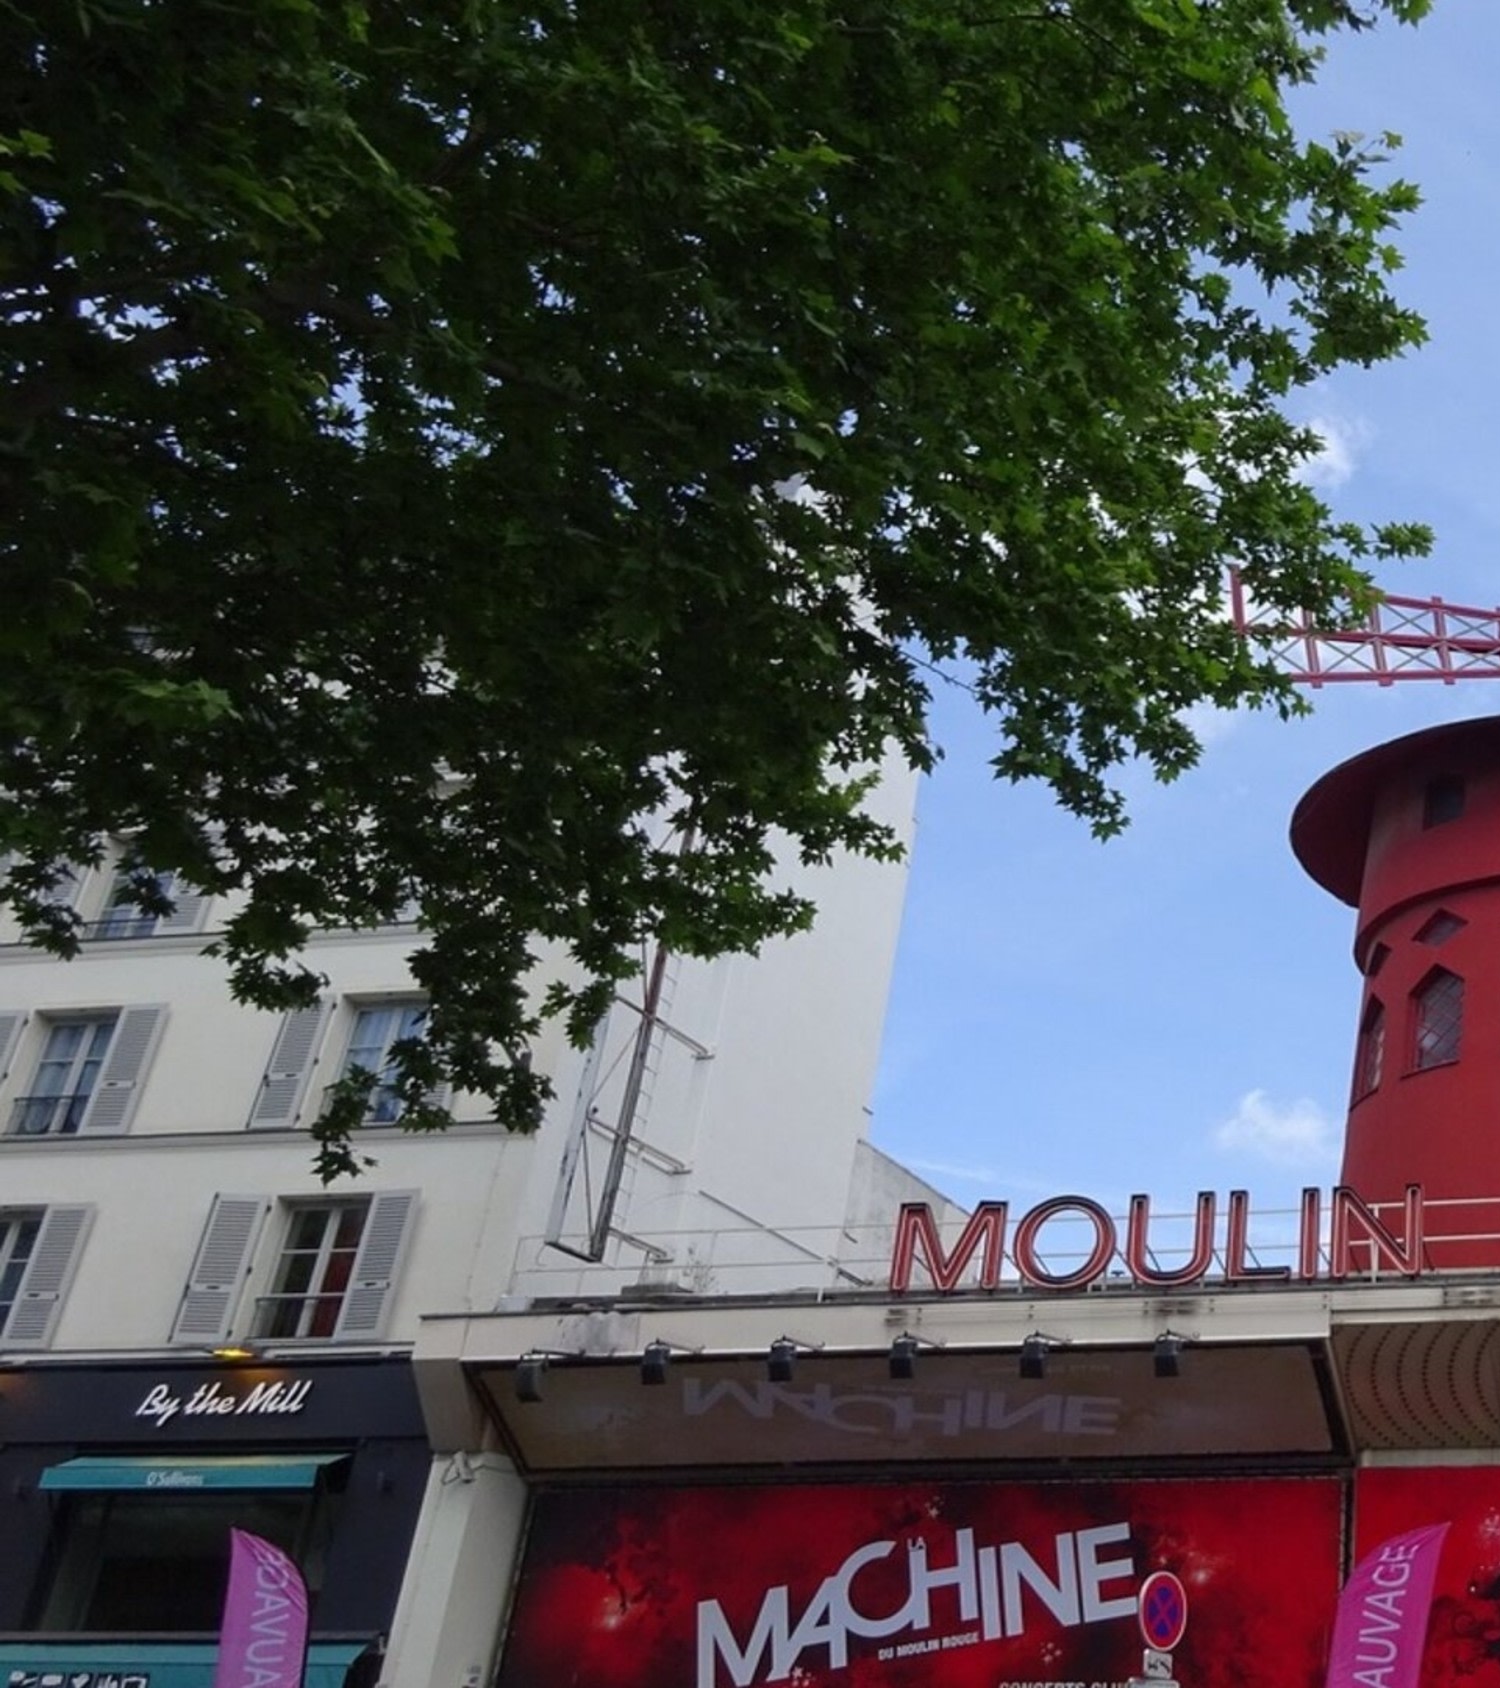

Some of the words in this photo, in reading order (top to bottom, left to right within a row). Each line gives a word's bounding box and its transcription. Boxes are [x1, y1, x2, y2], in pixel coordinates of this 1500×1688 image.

[890, 1184, 1423, 1294] MOULIN
[135, 1383, 181, 1427] By
[184, 1381, 236, 1415] the
[234, 1379, 313, 1415] Mill
[697, 1522, 1138, 1688] MACHINE
[896, 1639, 941, 1657] MOULIN
